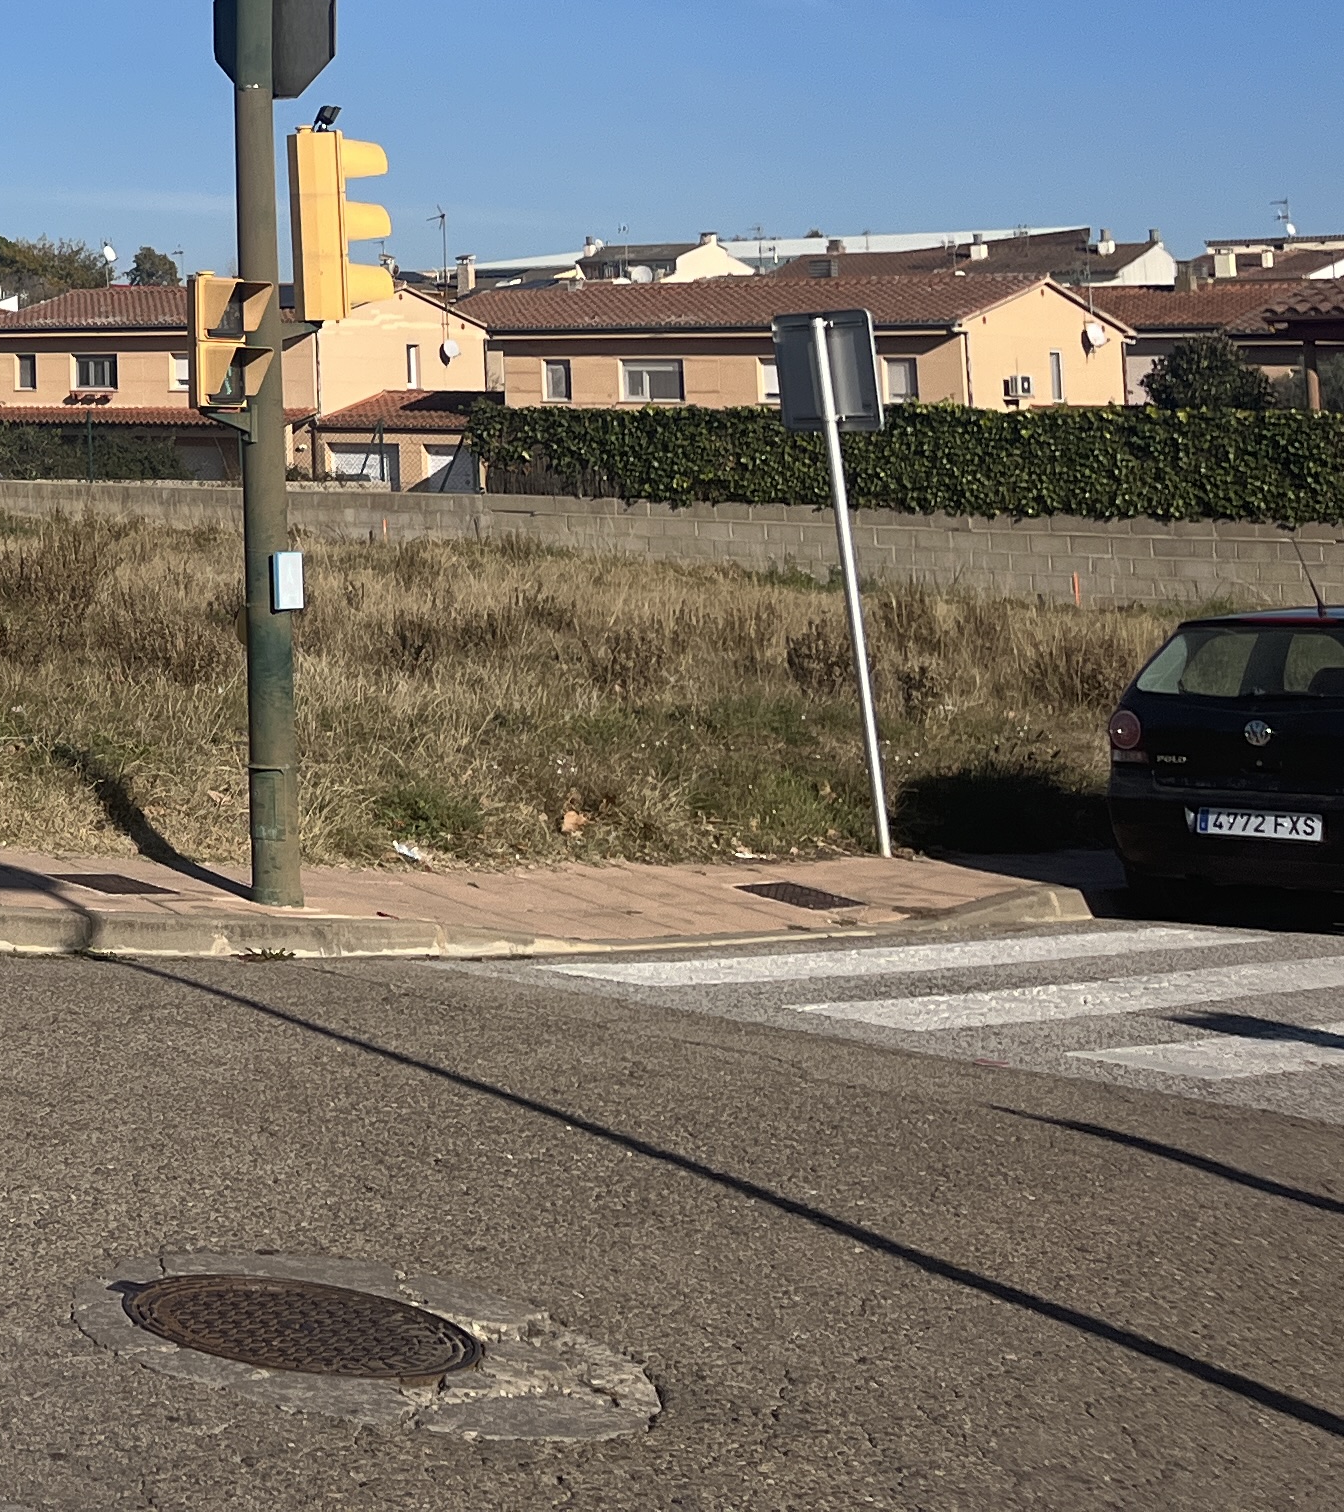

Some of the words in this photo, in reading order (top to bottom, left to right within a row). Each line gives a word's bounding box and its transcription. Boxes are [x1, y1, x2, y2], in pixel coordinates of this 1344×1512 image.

[1156, 754, 1187, 763] POLO
[1212, 811, 1266, 833] 4772
[1273, 815, 1315, 836] FXS
